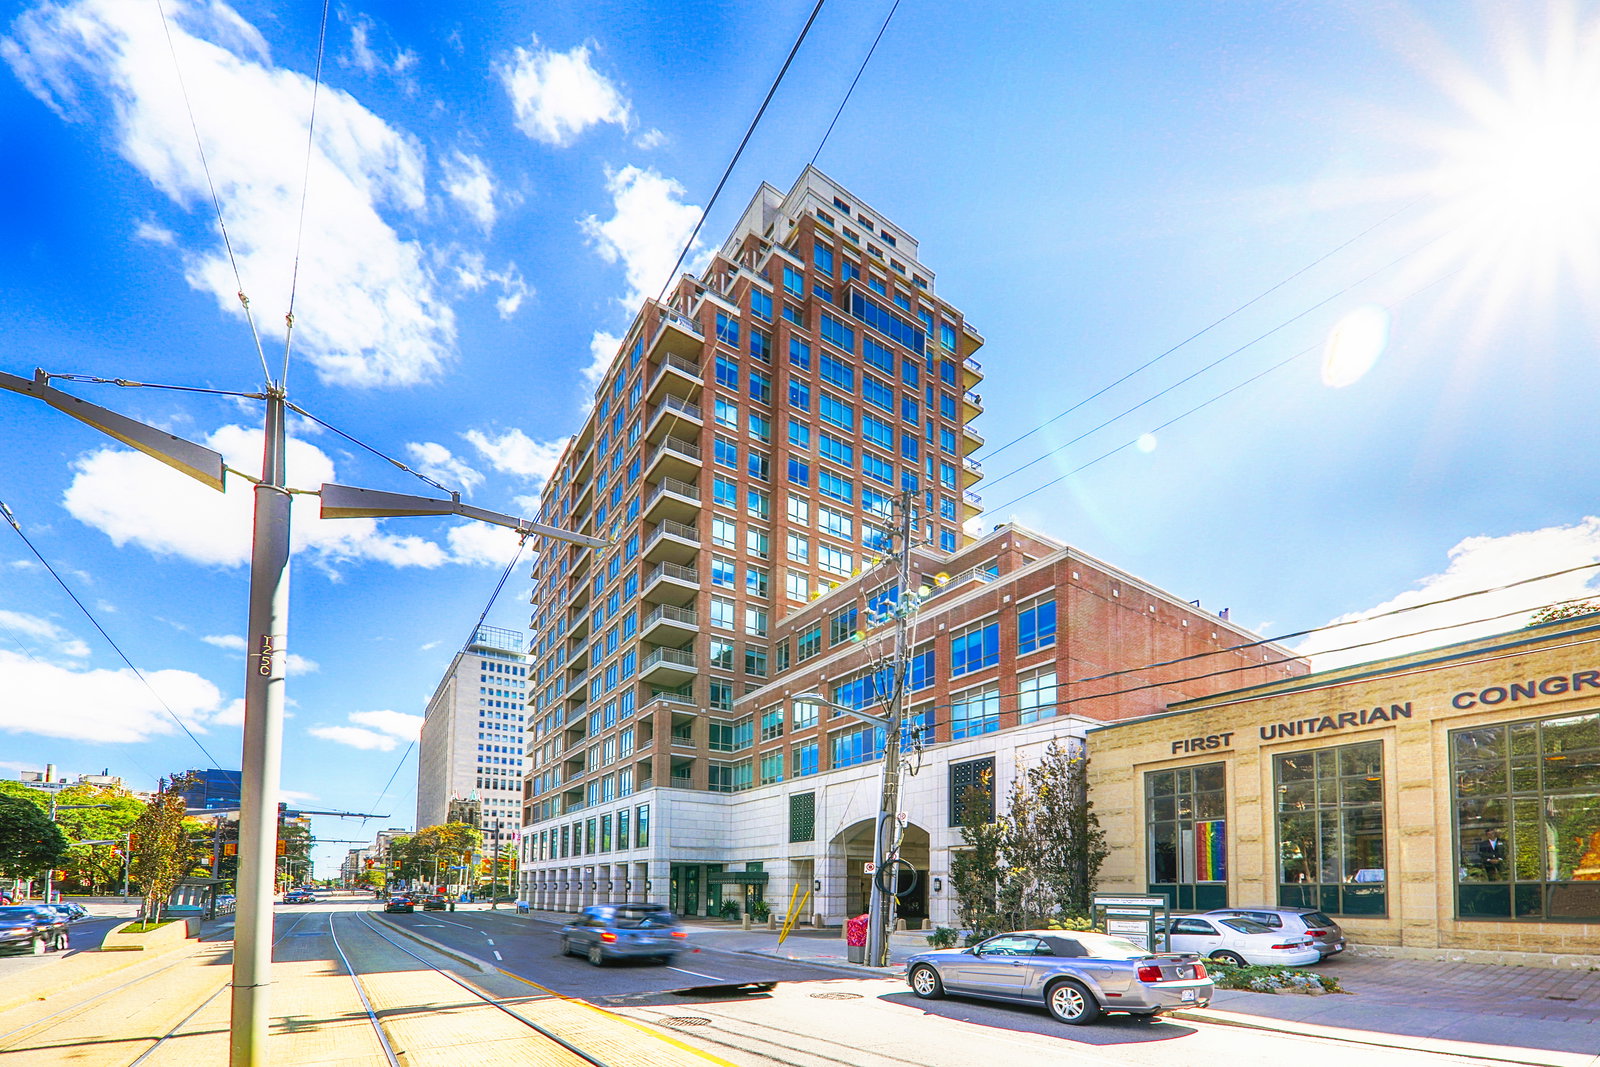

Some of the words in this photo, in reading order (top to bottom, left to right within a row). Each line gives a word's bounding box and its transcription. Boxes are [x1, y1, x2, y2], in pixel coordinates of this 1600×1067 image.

[259, 635, 273, 676] T25C
[1171, 732, 1234, 755] FIRST
[1259, 702, 1412, 740] UNITARIAN
[1452, 670, 1600, 709] CONGR
